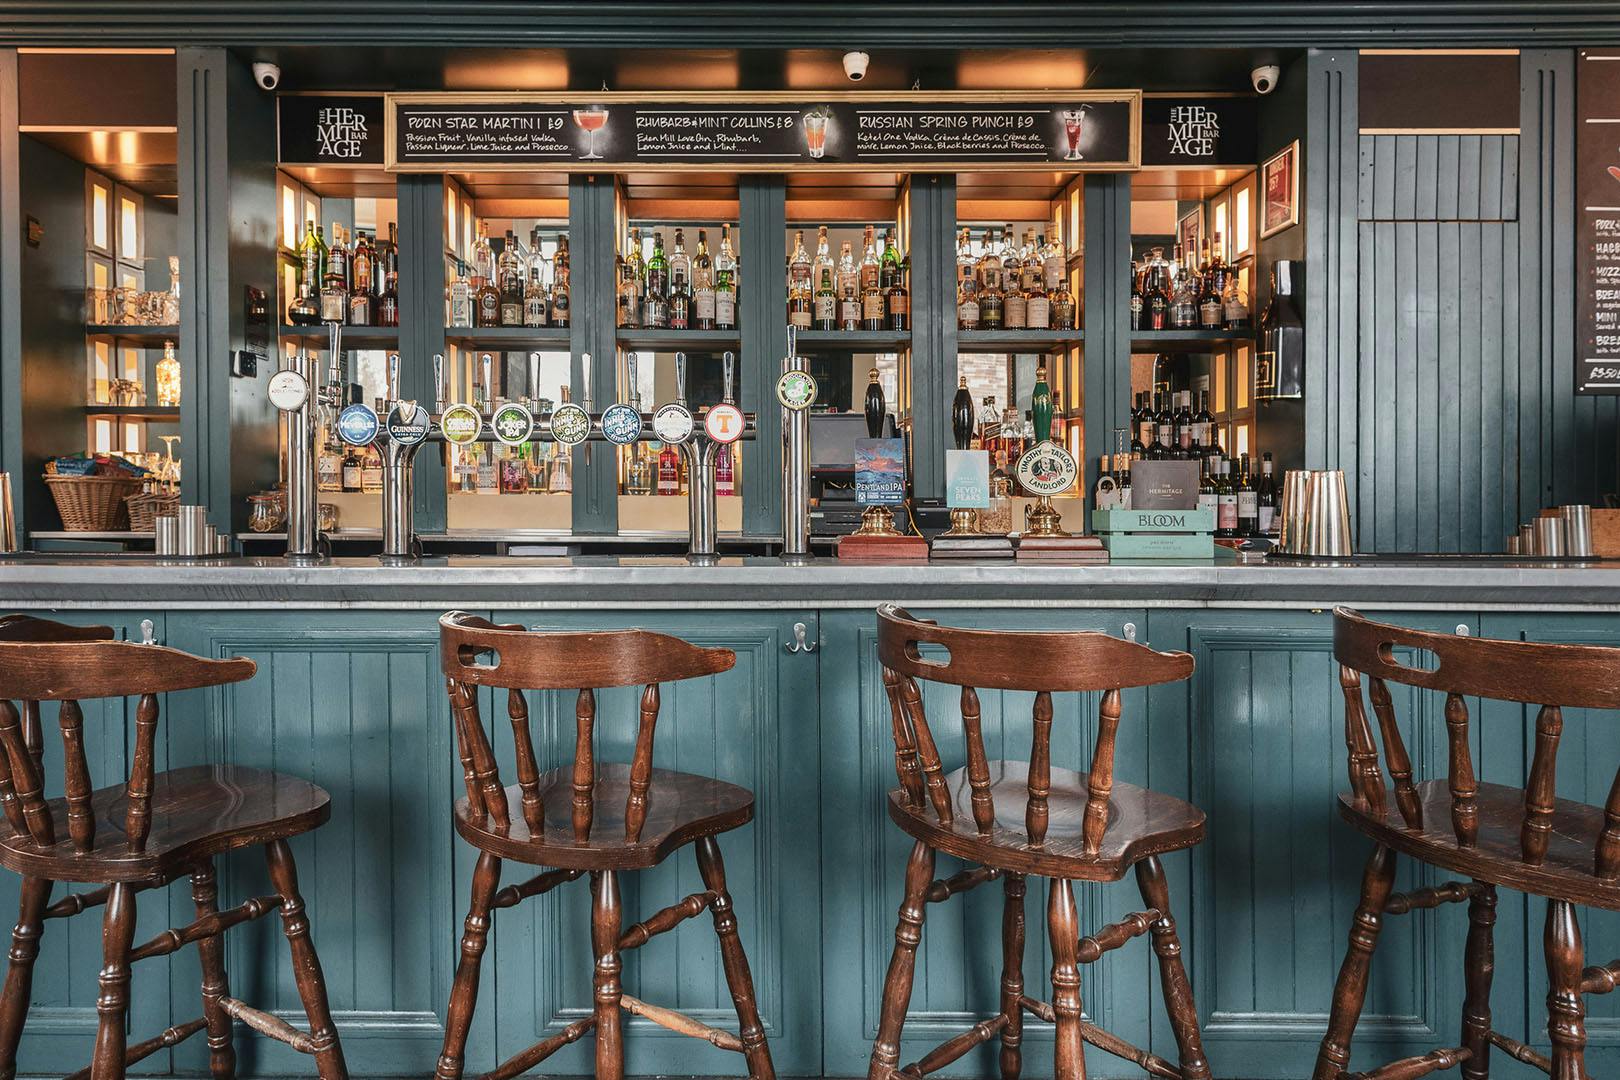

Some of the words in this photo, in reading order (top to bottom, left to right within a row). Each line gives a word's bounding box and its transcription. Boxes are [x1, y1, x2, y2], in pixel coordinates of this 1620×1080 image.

[408, 117, 442, 129] PORN
[445, 117, 478, 129] STAR
[483, 117, 541, 129] MARTINI
[731, 117, 775, 129] COLLINS
[859, 116, 912, 129] RUSSIAN
[919, 116, 968, 128] SPRING
[972, 116, 1013, 128] PUNCH
[1017, 116, 1034, 129] £9
[351, 131, 368, 140] BAR
[406, 133, 437, 142] Passion
[466, 133, 497, 142] Vanilla
[499, 133, 528, 142] infused
[531, 133, 556, 143] Vodka
[637, 133, 659, 142] Eden
[660, 133, 675, 142] Mill
[678, 134, 695, 142] Love
[857, 132, 882, 141] Ketel
[883, 132, 902, 141] One
[962, 133, 972, 141] de
[1028, 133, 1041, 141] de
[1202, 129, 1220, 138] BAR
[470, 142, 489, 151] Lime
[490, 142, 512, 151] Juice
[515, 142, 530, 151] and
[637, 142, 665, 151] Lemon
[667, 142, 691, 150] Juice
[693, 142, 711, 150] and
[880, 142, 908, 150] Lemon
[991, 141, 1009, 150] and
[1596, 312, 1617, 322] MINI
[391, 425, 424, 433] GUINNESS
[498, 419, 526, 430] JOKER
[1021, 448, 1042, 473] TIMOTHY
[1051, 448, 1074, 473] TAYLOR'S
[856, 483, 890, 491] PENTLAND
[1028, 477, 1067, 490] LANDLORD
[1138, 514, 1185, 527] BLOOM
